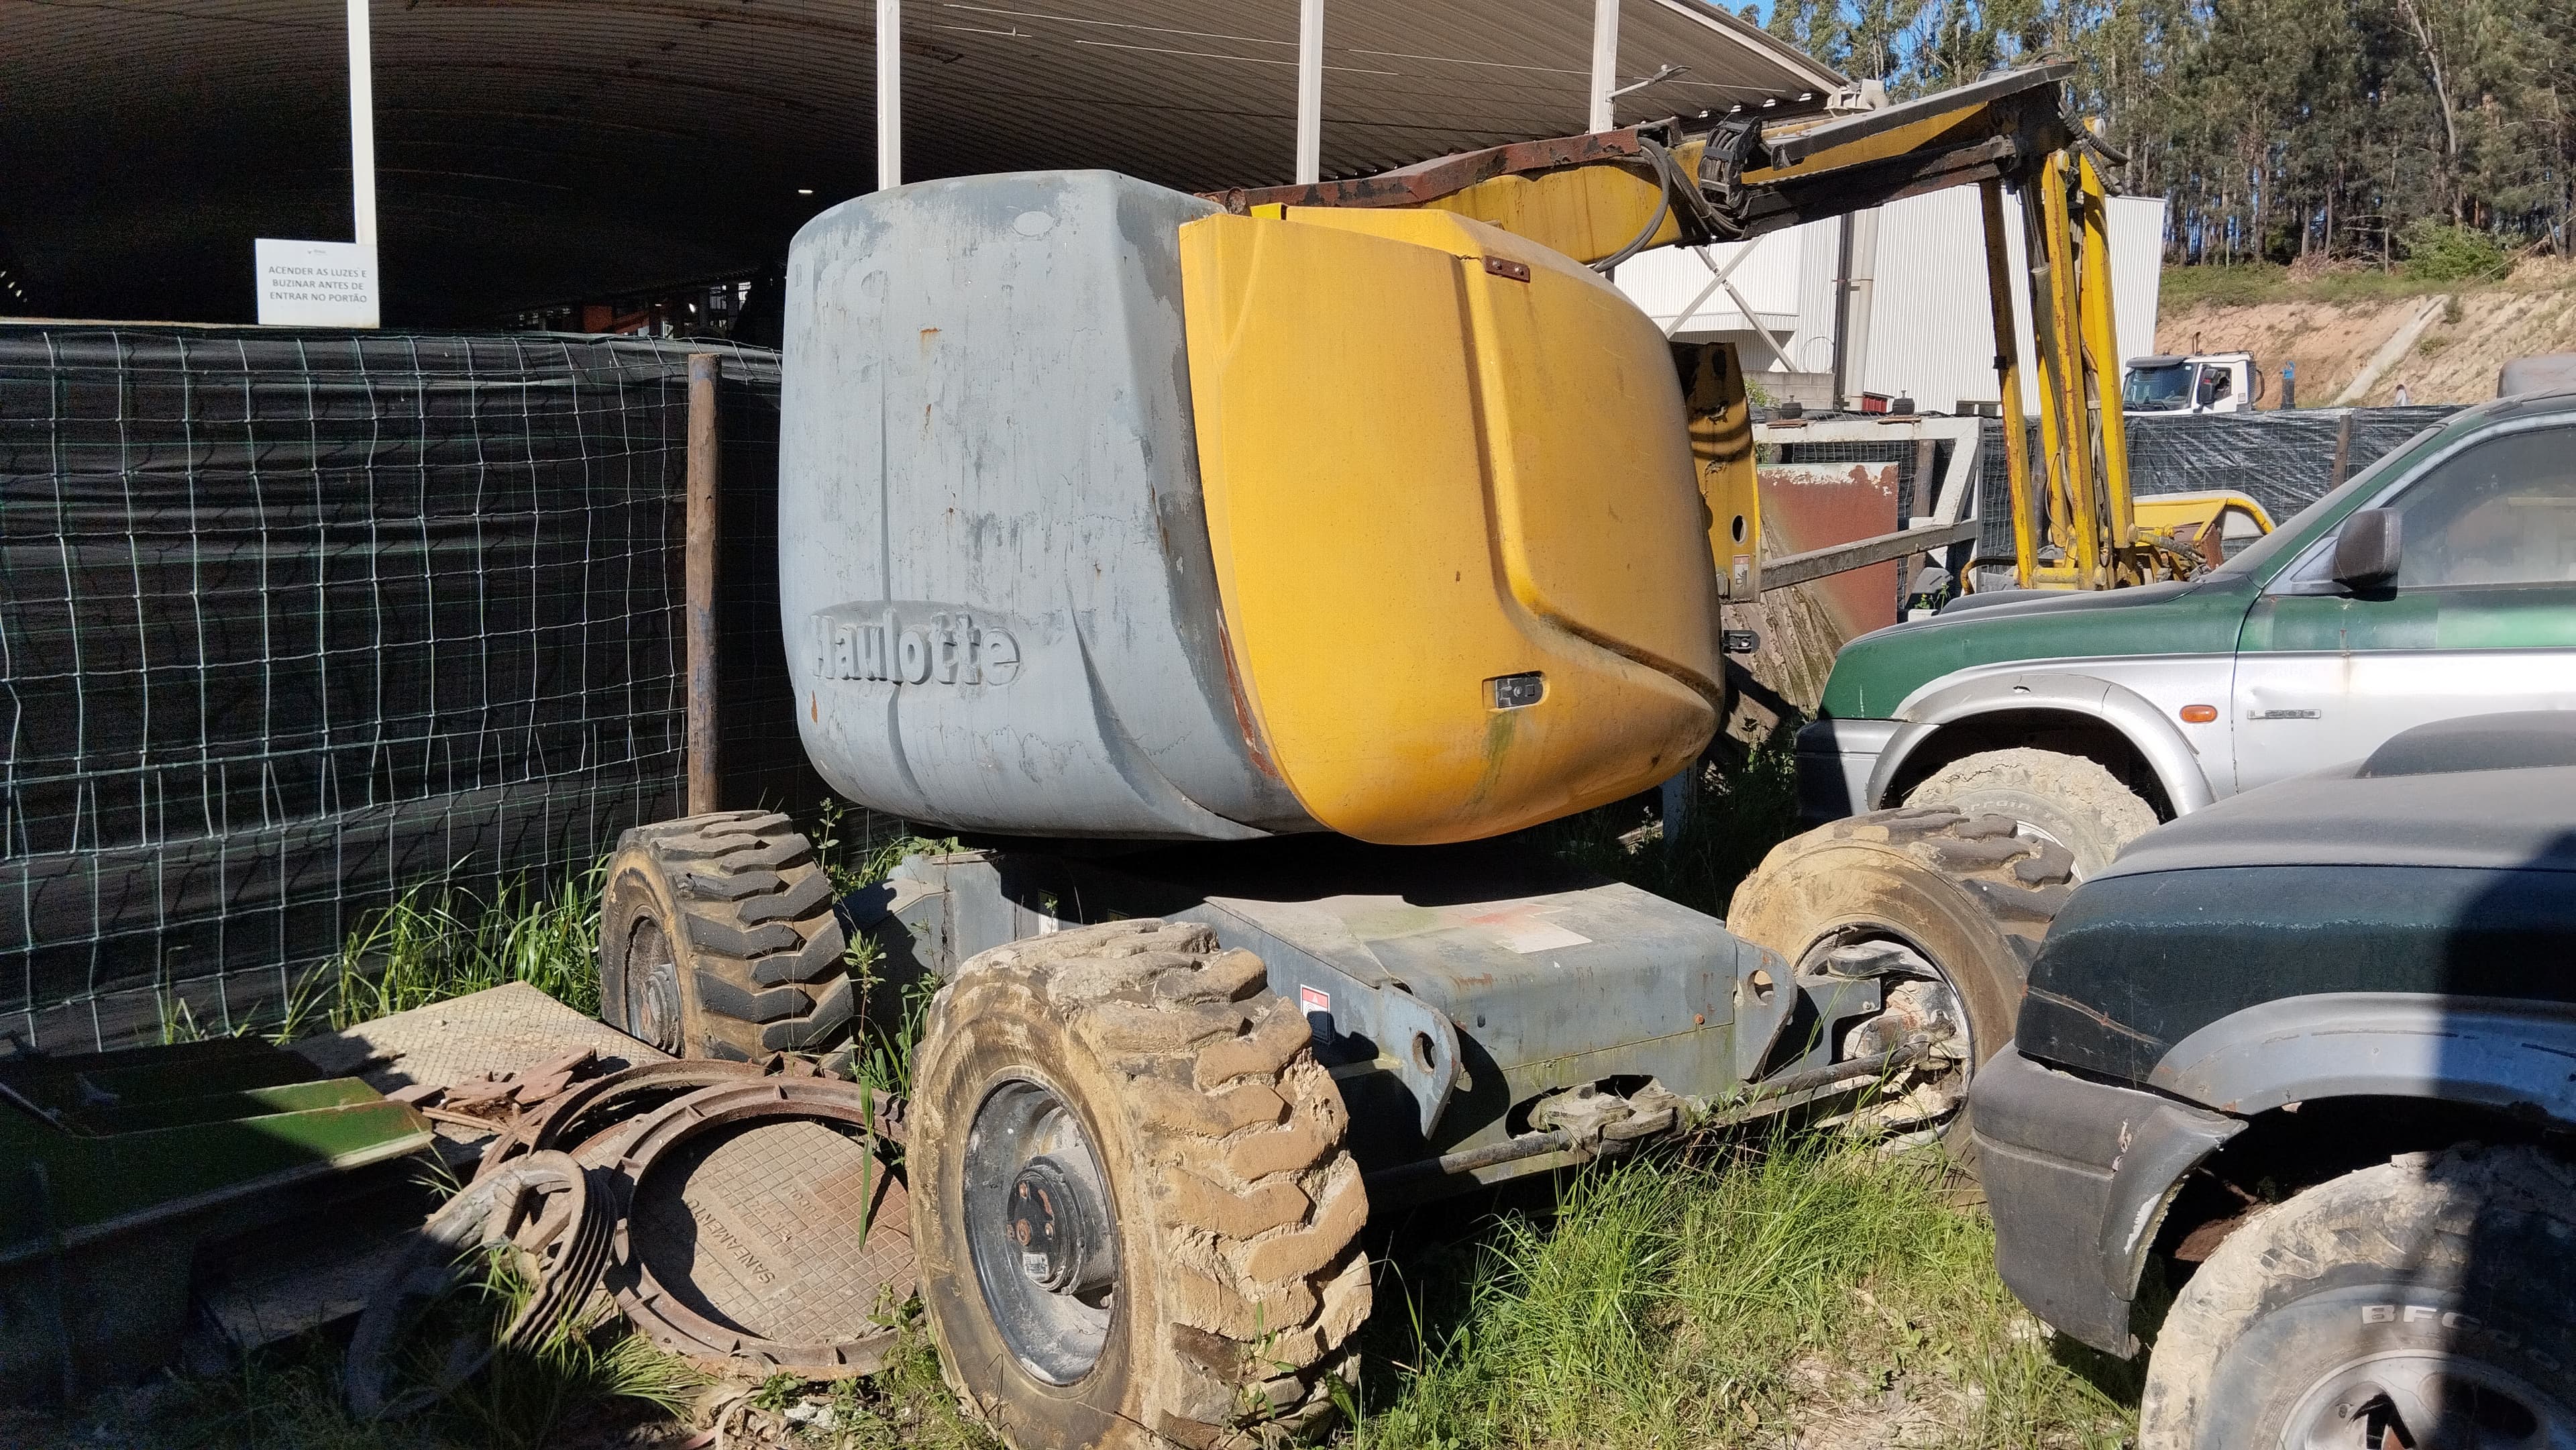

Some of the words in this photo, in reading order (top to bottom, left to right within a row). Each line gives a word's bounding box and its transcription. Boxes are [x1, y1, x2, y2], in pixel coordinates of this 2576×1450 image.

[268, 266, 313, 275] ACENDER
[316, 268, 328, 276] AS
[331, 268, 358, 278] LUZES
[362, 270, 367, 278] E
[272, 278, 316, 289] BUZINAR
[318, 280, 349, 290] ANTES
[352, 282, 364, 291] DE
[270, 291, 309, 301] ENTRAR
[311, 293, 326, 301] NO
[329, 293, 368, 303] PORTÃO
